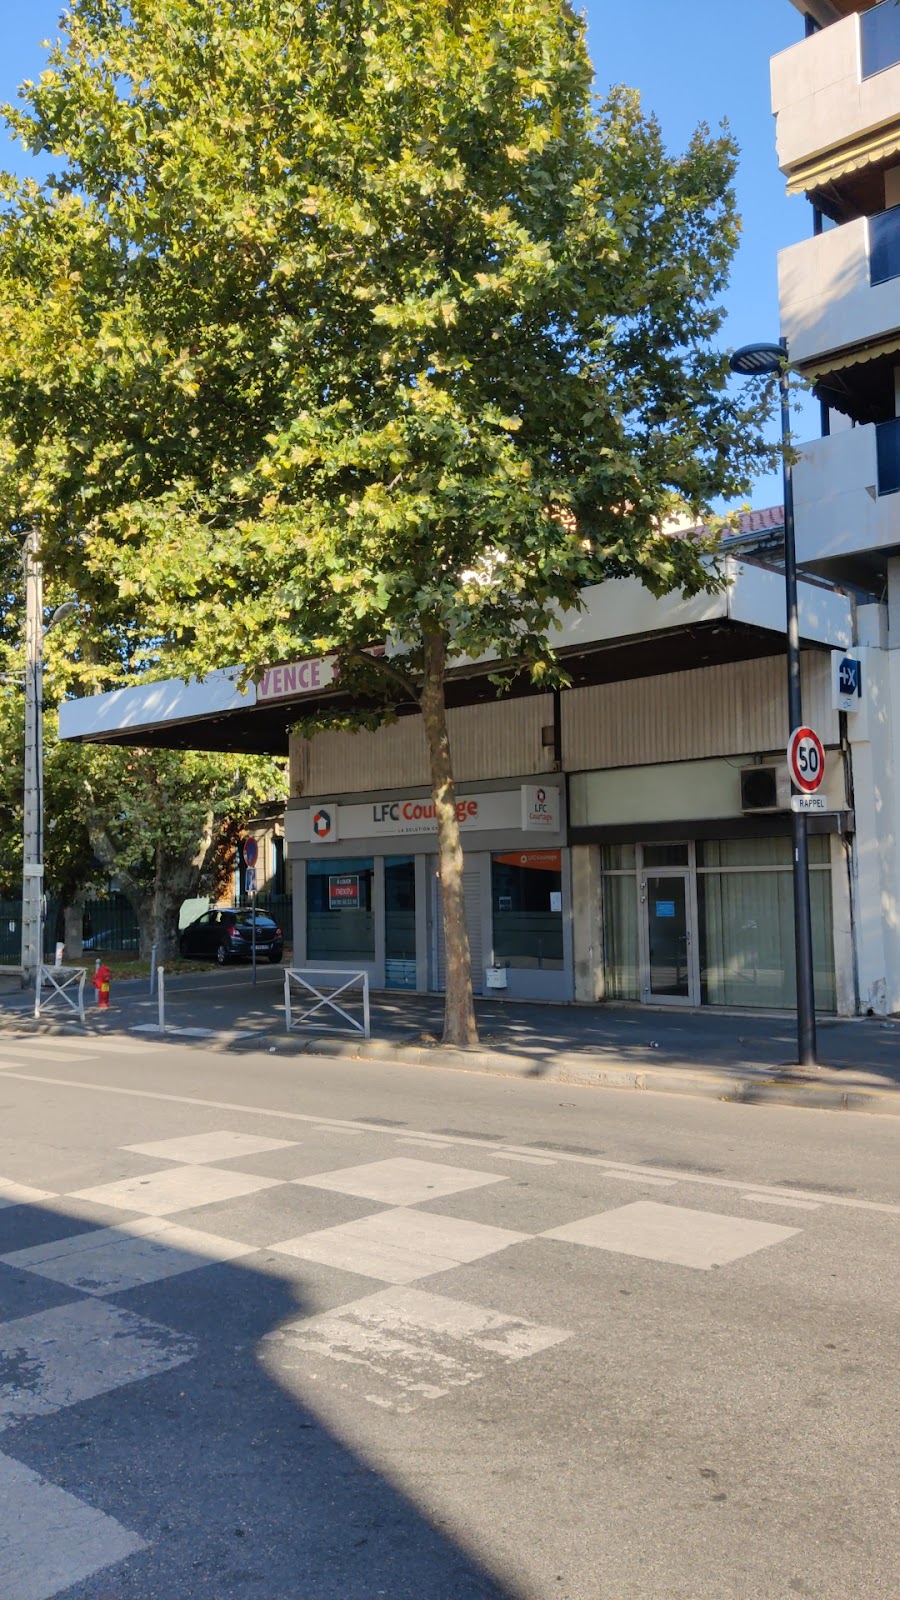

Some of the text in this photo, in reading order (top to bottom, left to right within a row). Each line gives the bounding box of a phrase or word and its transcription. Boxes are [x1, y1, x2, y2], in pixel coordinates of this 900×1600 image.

[260, 661, 320, 696] VENCE
[799, 746, 818, 772] 50
[535, 804, 547, 812] LFC
[799, 799, 824, 808] RAPPEL
[373, 803, 399, 822] LFC
[529, 813, 552, 822] Courtage
